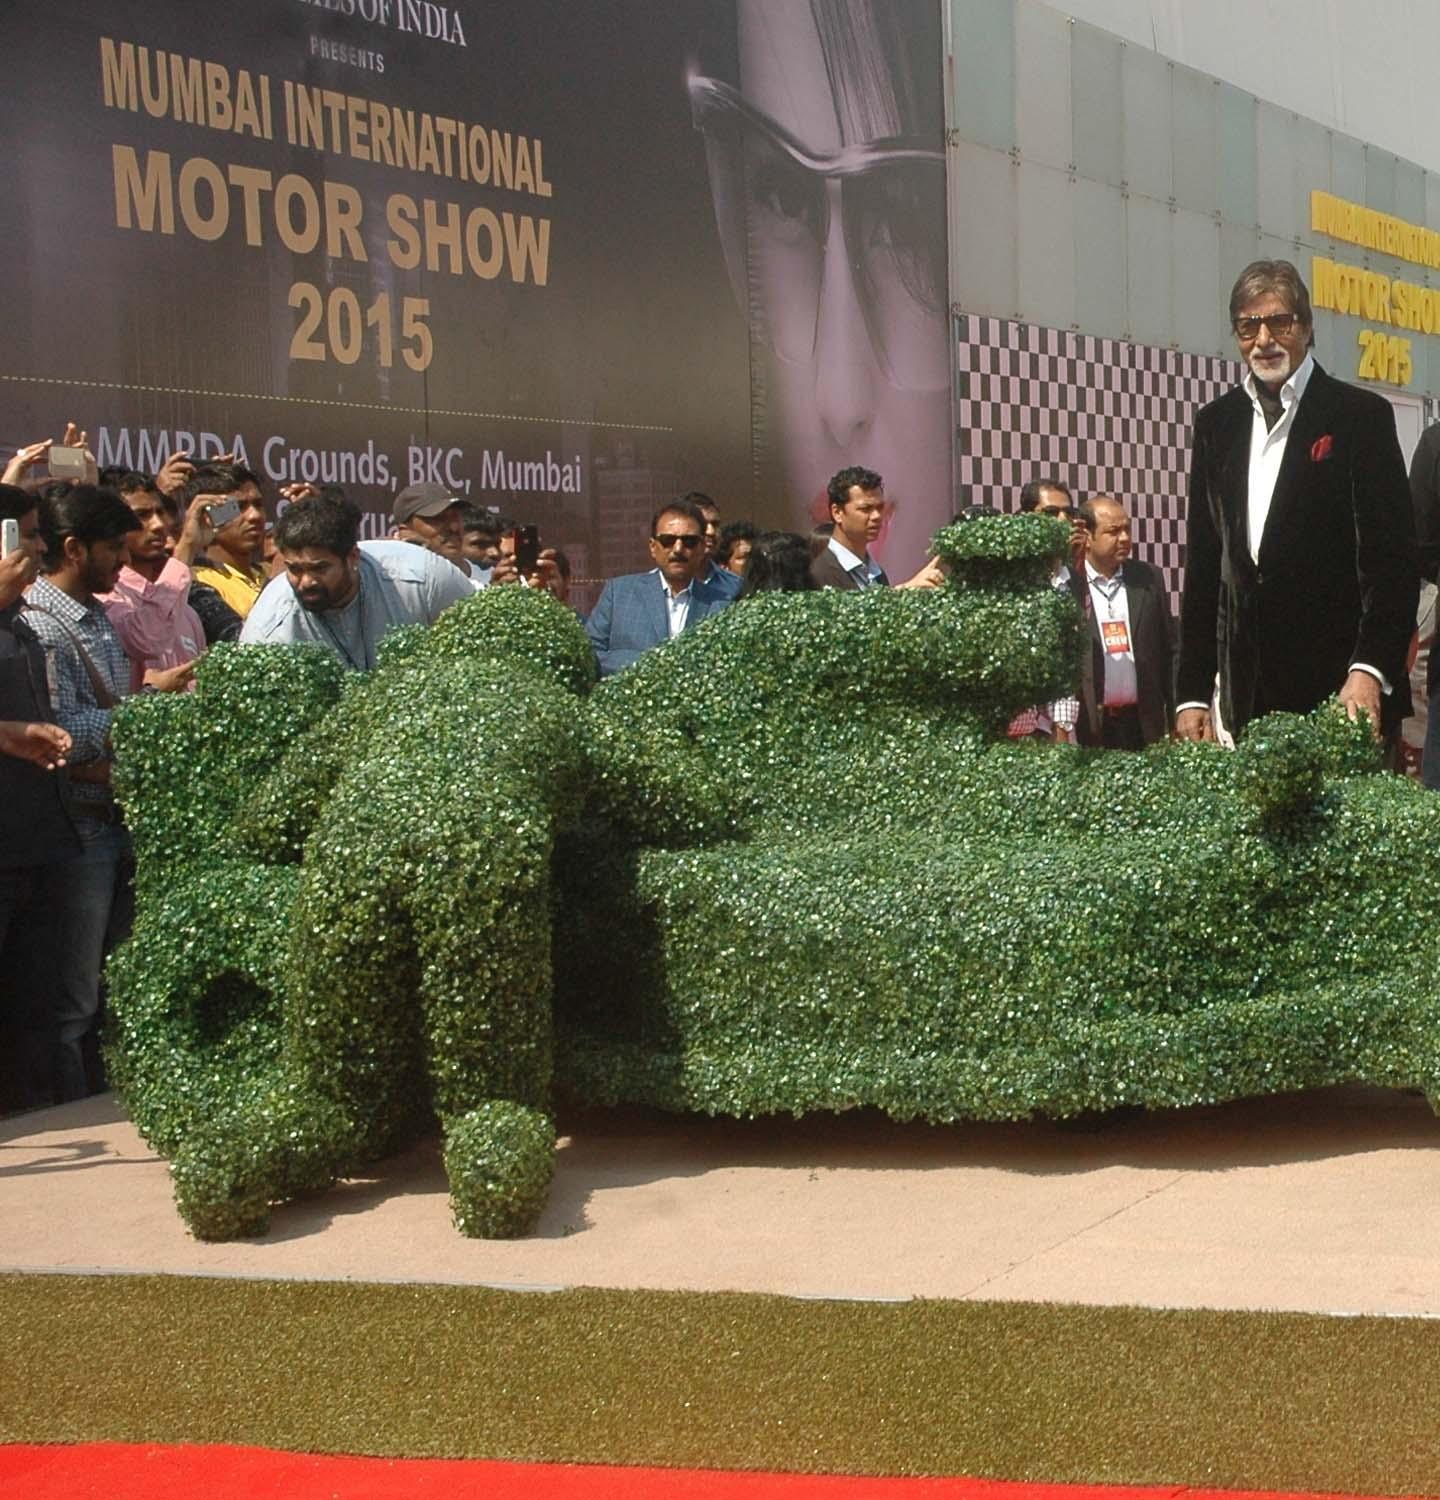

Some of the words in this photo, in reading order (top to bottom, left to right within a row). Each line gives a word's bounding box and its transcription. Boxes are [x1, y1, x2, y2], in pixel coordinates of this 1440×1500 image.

[310, 34, 385, 73] PRESENTS
[398, 0, 467, 47] INDIA
[100, 37, 273, 140] MUMBAI
[284, 80, 552, 197] INTERNATIONAL
[112, 144, 368, 262] MOTOR
[386, 194, 550, 286] SHOW
[1312, 256, 1391, 323] MOTOR
[288, 282, 433, 372] 2015
[1359, 329, 1412, 386] 2015
[263, 436, 398, 492] Grounds,
[408, 445, 472, 495] BKC,
[481, 451, 582, 493] Mumbai
